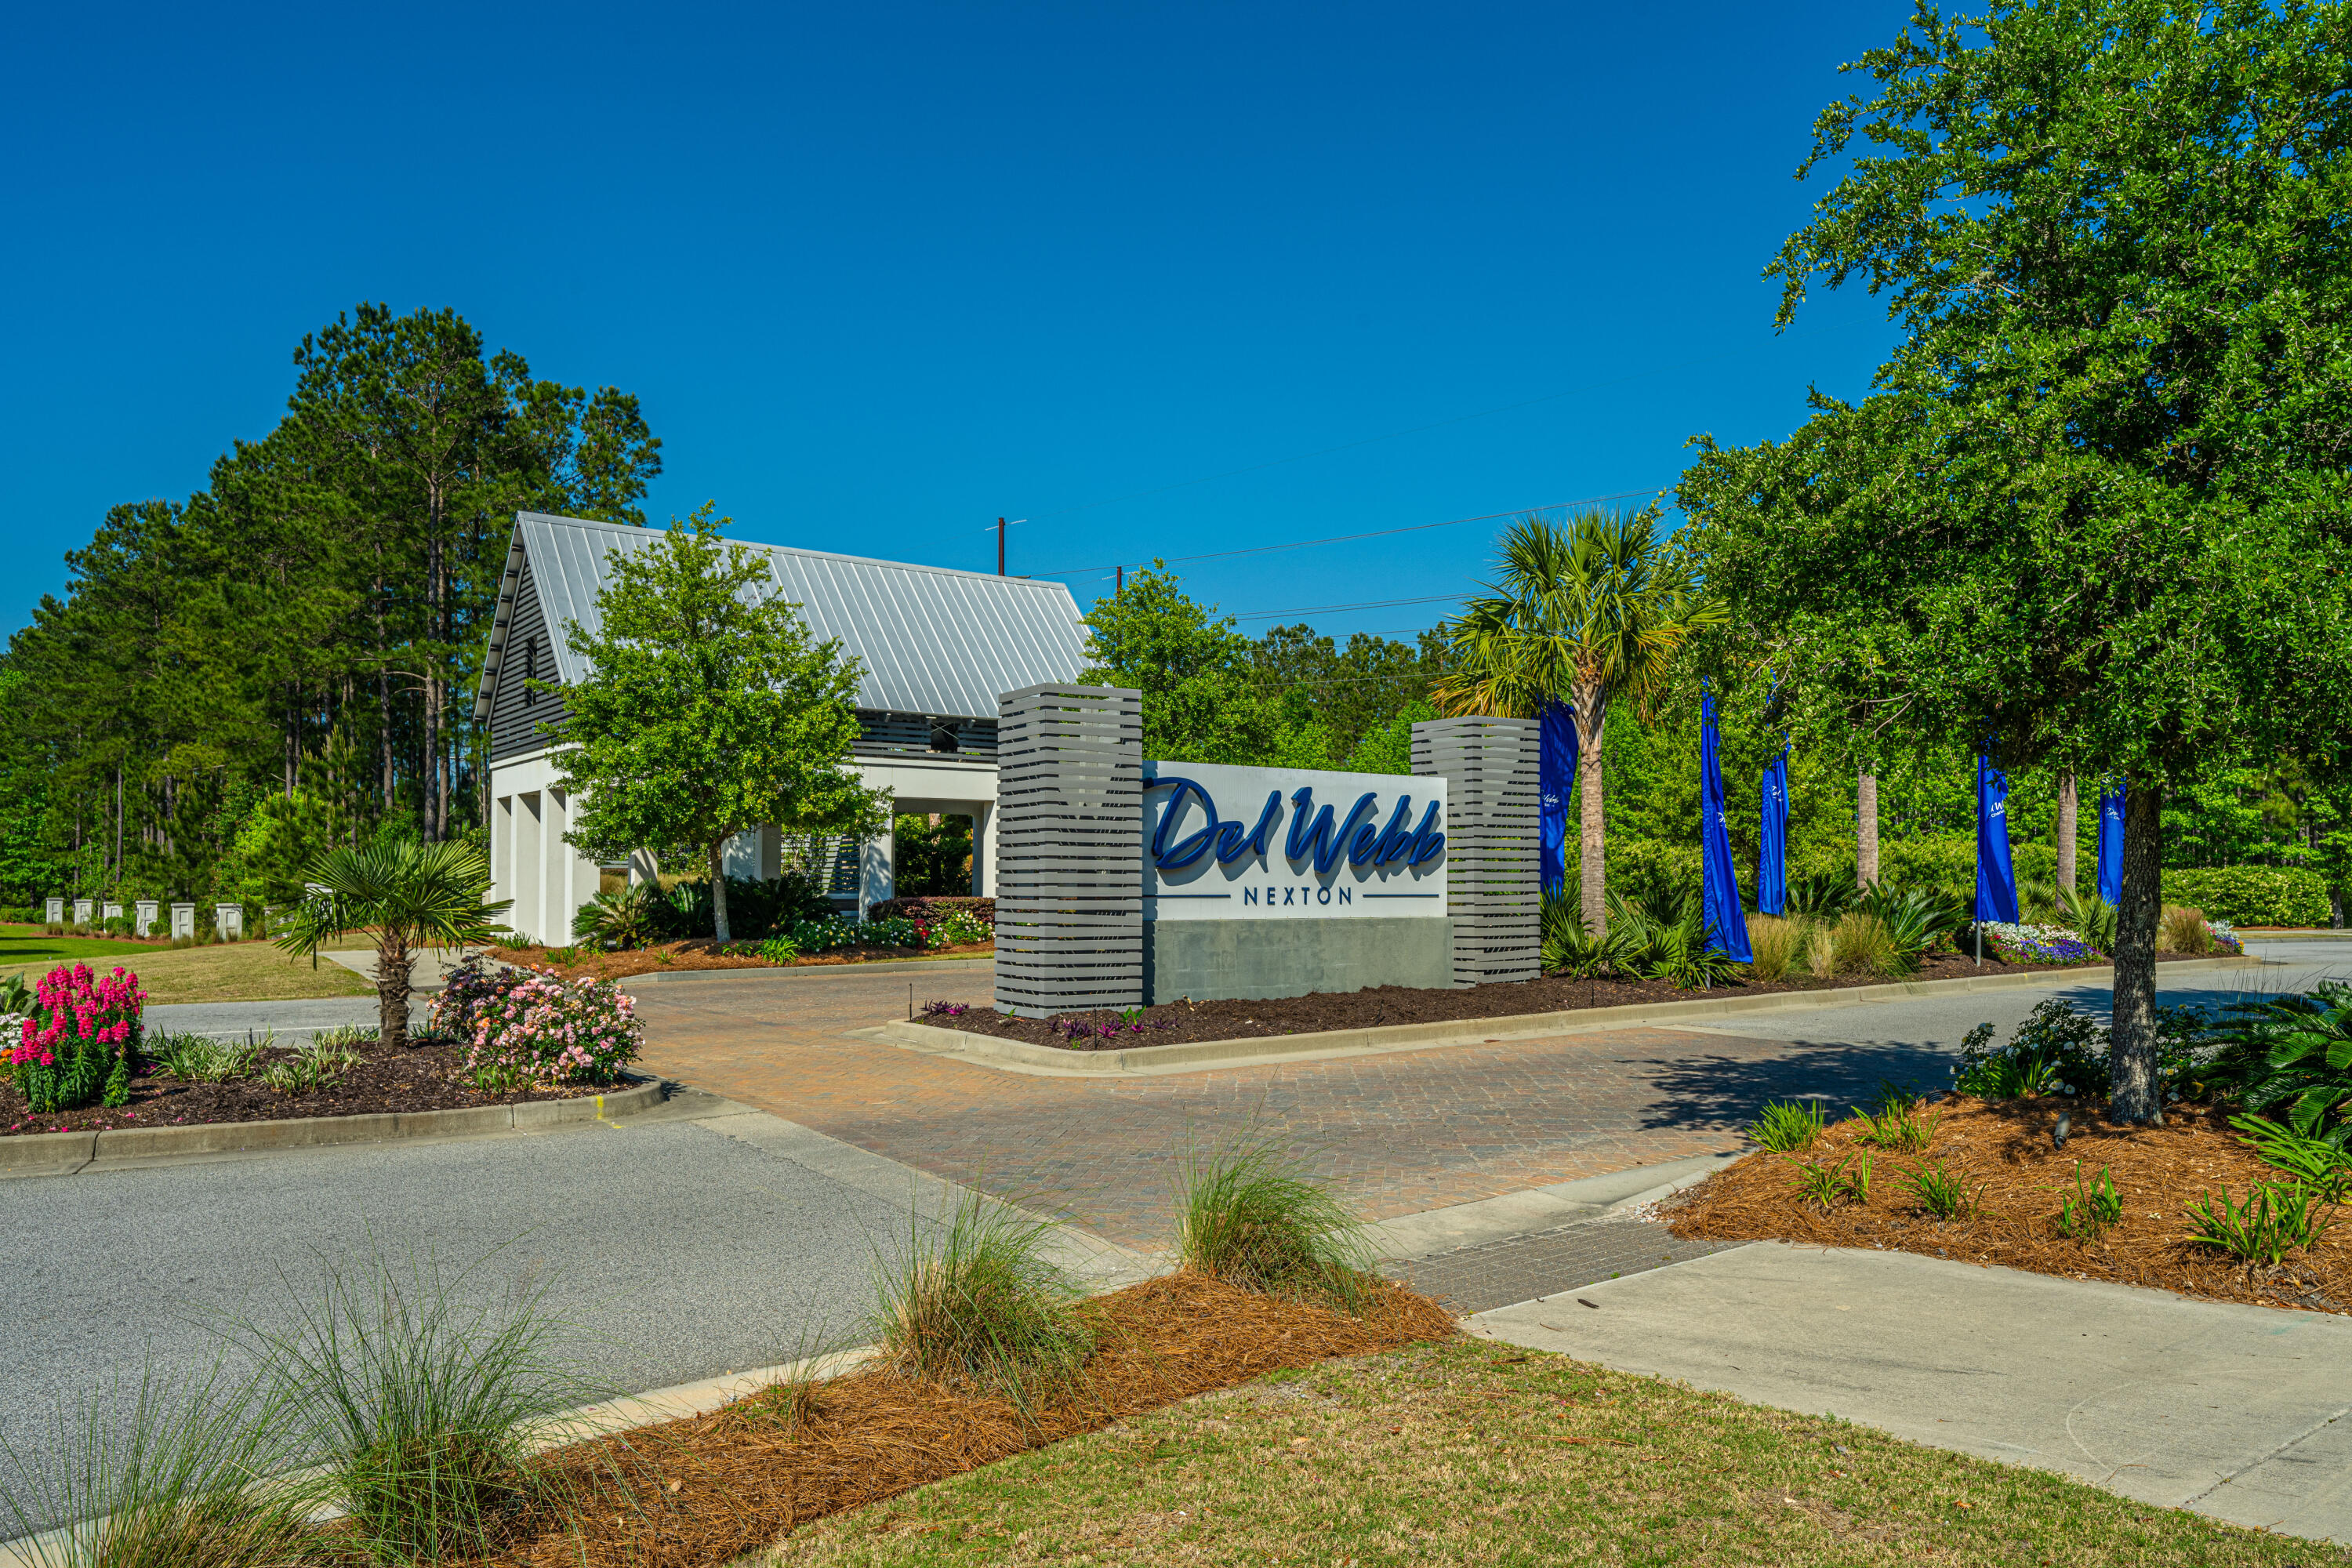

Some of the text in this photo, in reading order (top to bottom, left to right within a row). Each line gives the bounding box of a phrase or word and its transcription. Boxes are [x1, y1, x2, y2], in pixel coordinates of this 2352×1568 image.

[1140, 777, 1446, 873] Del Webb
[1244, 886, 1352, 906] NEXTON
